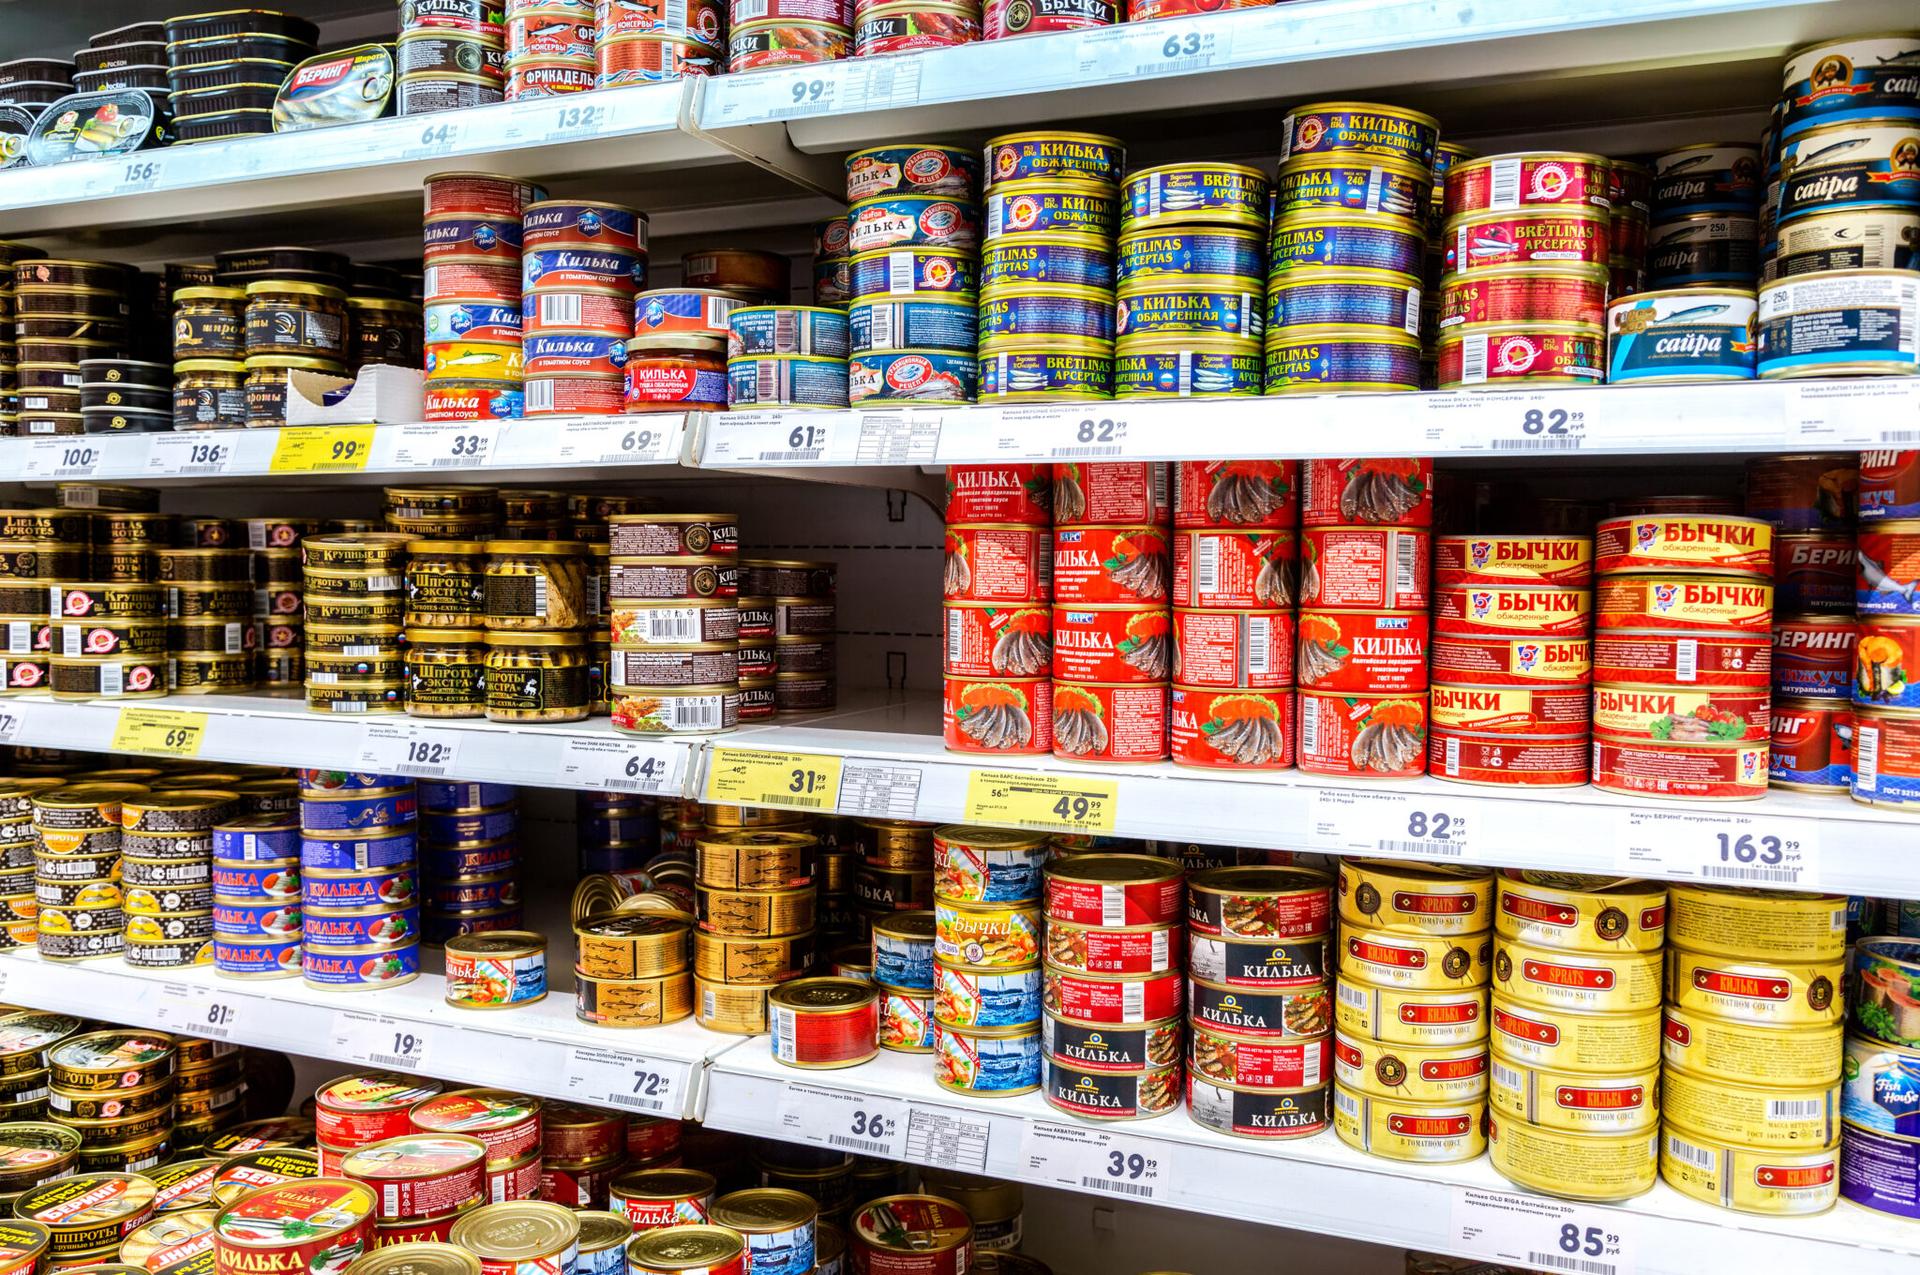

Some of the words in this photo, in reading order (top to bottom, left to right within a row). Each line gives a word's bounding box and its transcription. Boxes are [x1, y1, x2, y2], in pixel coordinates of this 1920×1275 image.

[617, 20, 653, 29] КОНСЕРВЫ
[530, 43, 566, 51] КОНСЕРВЫ
[1163, 32, 1200, 58] 63
[1204, 33, 1215, 41] 99
[297, 64, 346, 84] БЕРИНГ
[792, 79, 824, 103] 99
[558, 105, 595, 128] 132
[422, 124, 449, 144] 64
[1349, 115, 1418, 138] КИЛЬКА
[1339, 131, 1422, 151] ОБЖАРЕННАЯ
[1041, 143, 1105, 160] КИЛЬКА
[125, 163, 153, 182] 156
[1031, 157, 1111, 172] ОБЖАРЕННАЯ
[1658, 180, 1706, 201] сайра
[1795, 176, 1858, 201] сайра
[579, 218, 592, 226] Fish
[1515, 223, 1594, 239] BRĒTLINAS
[1710, 223, 1726, 232] 250
[1524, 239, 1587, 250] APCEPTAS
[556, 252, 620, 270] Килька
[1143, 296, 1211, 310] КИЛЬКА
[1773, 292, 1788, 304] 250
[1137, 311, 1219, 322] ОБЖАРЕННАЯ
[536, 339, 594, 353] Килька
[1655, 334, 1722, 358] сайра
[543, 359, 570, 367] томатном
[639, 370, 687, 381] КИЛЬКА
[1055, 370, 1105, 383] APCEPTAS
[1523, 409, 1568, 434] 82
[1571, 412, 1584, 420] 99
[1570, 422, 1585, 430] руб
[621, 430, 652, 450] 69
[653, 432, 662, 440] 99
[788, 426, 814, 448] 61
[1077, 419, 1115, 443] 82
[1116, 422, 1127, 430] 99
[190, 445, 220, 463] 136
[332, 441, 357, 460] 99
[451, 435, 480, 455] 33
[63, 449, 92, 467] 100
[957, 472, 1021, 488] КИЛЬКА
[1665, 523, 1755, 546] БЫЧКИ
[1496, 541, 1579, 561] БЫЧКИ
[1663, 544, 1721, 553] обжаренные
[415, 574, 472, 589] ШПРОТЫ
[1498, 593, 1580, 612] БЫЧКИ
[1684, 585, 1765, 607] БЫЧКИ
[1066, 612, 1094, 624] БАРС
[1497, 613, 1550, 621] обжаренные
[1682, 606, 1738, 615] обжаренные
[1376, 618, 1408, 630] БАРС
[1056, 630, 1114, 649] КИЛЬКА
[1352, 637, 1422, 656] КИЛЬКА
[1772, 628, 1856, 649] БЕРИНГ
[419, 665, 478, 679] ШПРОТЫ
[1781, 686, 1836, 694] натуральный
[1433, 690, 1501, 711] БЫЧКИ
[1600, 692, 1675, 714] БЫЧКИ
[1474, 716, 1509, 727] томатном
[165, 729, 186, 747] 69
[408, 741, 442, 764] 182
[625, 756, 656, 778] 64
[789, 769, 815, 794] 31
[1053, 796, 1089, 820] 49
[1091, 801, 1101, 809] 99
[1408, 811, 1451, 839] 82
[1453, 818, 1465, 826] 99
[1452, 828, 1466, 836] руб
[1717, 833, 1784, 865] 163
[1786, 841, 1800, 850] 99
[1786, 853, 1801, 861] руб
[309, 881, 375, 897] КИЛЬКА
[954, 917, 1012, 936] Бычки
[1418, 916, 1444, 925] TOMATO
[1446, 917, 1463, 926] SAUCE
[217, 949, 274, 963] КИЛЬКА
[1243, 963, 1313, 978] КИЛЬКА
[1550, 967, 1585, 985] SPRATS
[1537, 986, 1544, 994] IN
[1546, 987, 1573, 999] TOMATO
[1576, 990, 1597, 1001] SAUCE
[1710, 996, 1751, 1010] ТОМАТНОМ
[1753, 1000, 1776, 1012] СОУСЕ
[208, 1004, 227, 1024] 81
[1202, 1006, 1267, 1028] КИЛЬКА
[394, 1033, 414, 1054] 19
[1065, 1044, 1131, 1064] КИЛЬКА
[633, 1070, 660, 1095] 72
[660, 1077, 670, 1085] 99
[1876, 1077, 1901, 1093] Fish
[1884, 1090, 1919, 1104] House
[851, 1110, 884, 1138] 36
[885, 1119, 895, 1128] 96
[884, 1129, 895, 1137] руб
[1033, 1124, 1053, 1133] Килька
[1053, 1127, 1086, 1137] АКВАТОРИЯ
[1107, 1150, 1145, 1180] 39
[1146, 1159, 1157, 1168] 99
[43, 1181, 118, 1218] БЕРИНГ
[1465, 1191, 1489, 1201] Килька
[1504, 1197, 1520, 1205] RIGA
[1521, 1200, 1559, 1212] балтийская
[1560, 1206, 1575, 1214] 250г
[1465, 1199, 1510, 1211] неразделанная
[1515, 1207, 1544, 1216] томатном
[54, 1226, 118, 1244] ШПРОТЫ
[1559, 1223, 1604, 1257] 85
[1606, 1234, 1620, 1244] 99
[54, 1242, 88, 1251] крупные
[96, 1238, 118, 1246] масле
[1606, 1247, 1620, 1255] руб
[220, 1247, 305, 1271] КИЛЬКА
